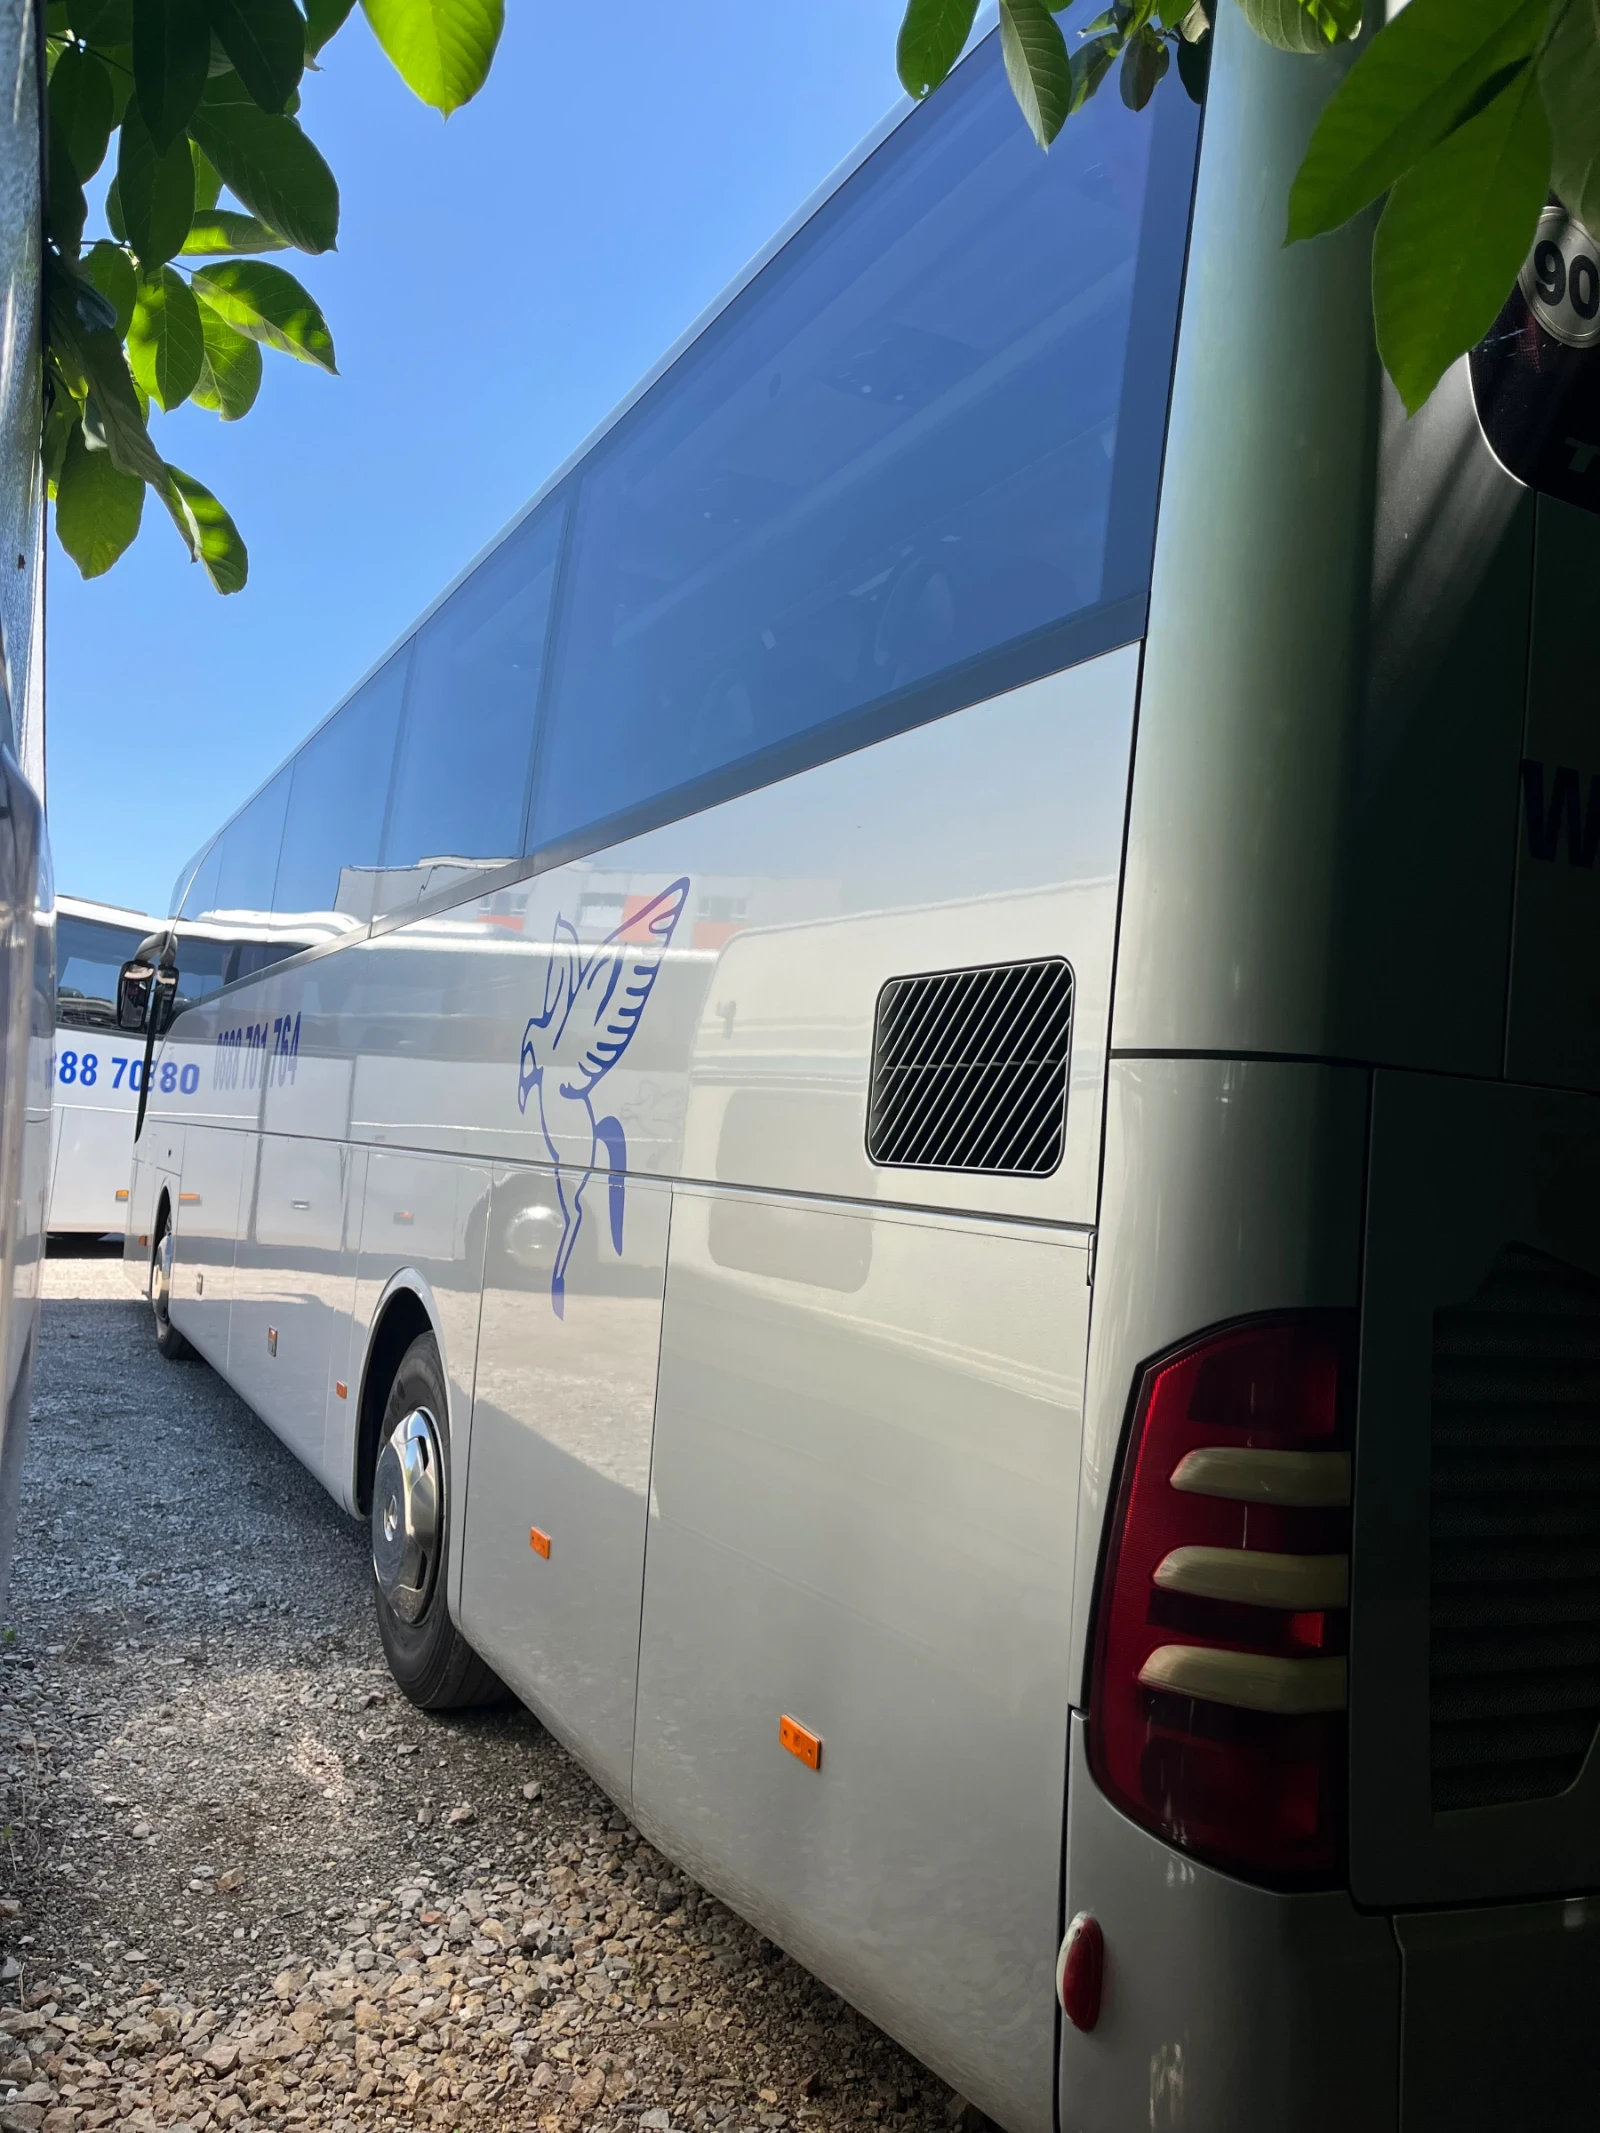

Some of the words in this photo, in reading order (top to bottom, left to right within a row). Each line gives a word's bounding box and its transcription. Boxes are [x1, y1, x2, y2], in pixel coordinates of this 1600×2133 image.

[1534, 240, 1600, 320] 90
[54, 1050, 99, 1087] 88
[269, 1011, 302, 1088] 764
